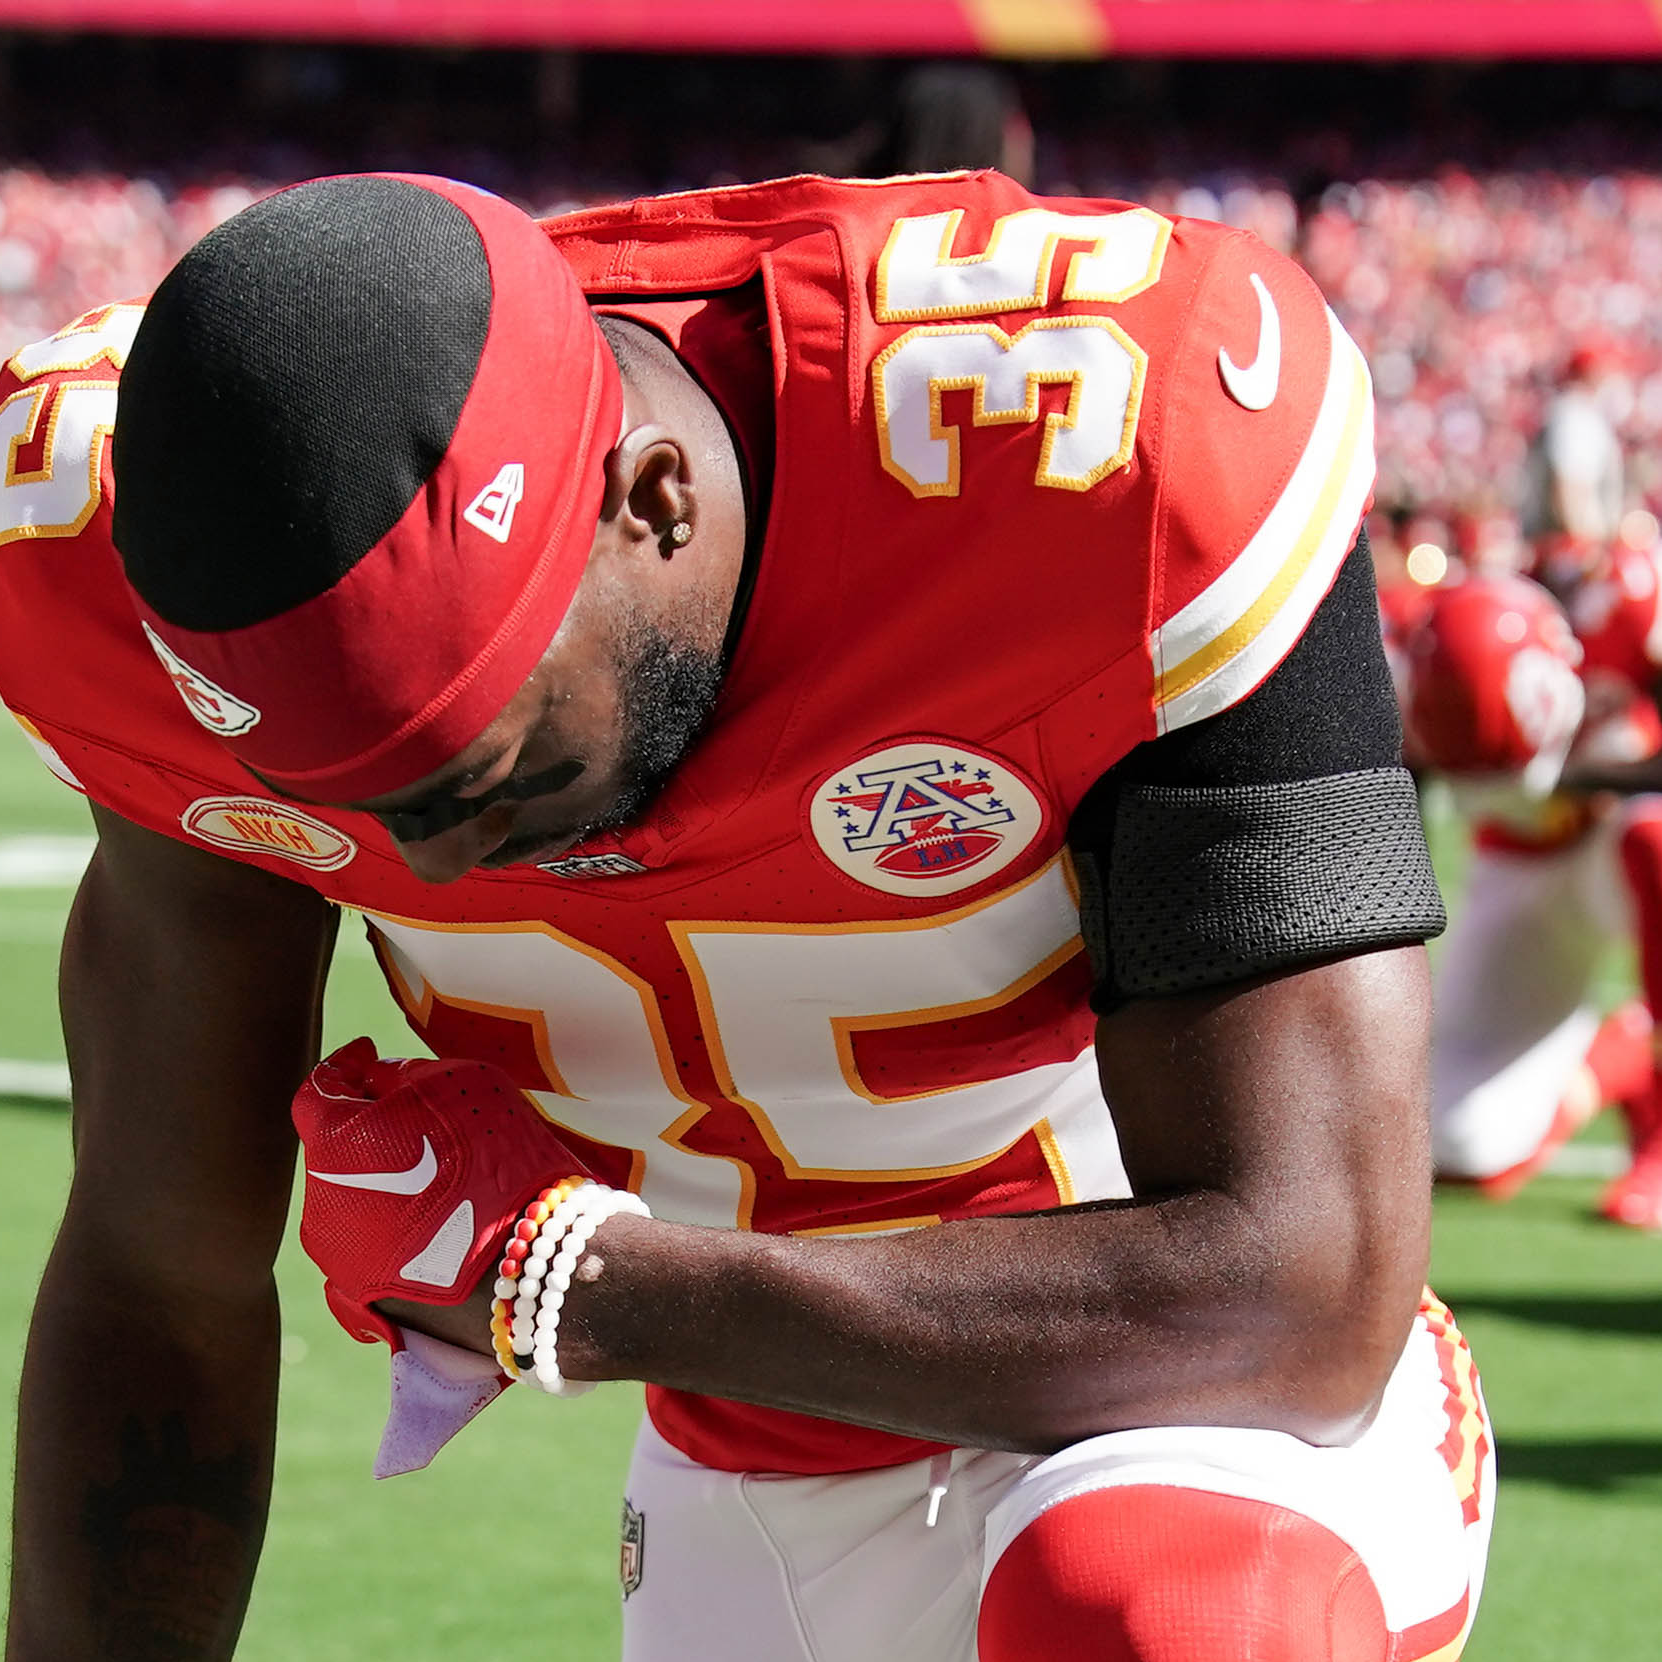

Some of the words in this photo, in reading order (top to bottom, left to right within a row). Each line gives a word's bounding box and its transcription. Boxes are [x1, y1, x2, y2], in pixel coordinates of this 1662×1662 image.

[871, 207, 1175, 499] 35
[221, 813, 320, 856] NKH
[843, 760, 1016, 852] A
[914, 840, 969, 868] LH
[363, 847, 1134, 1238] 35
